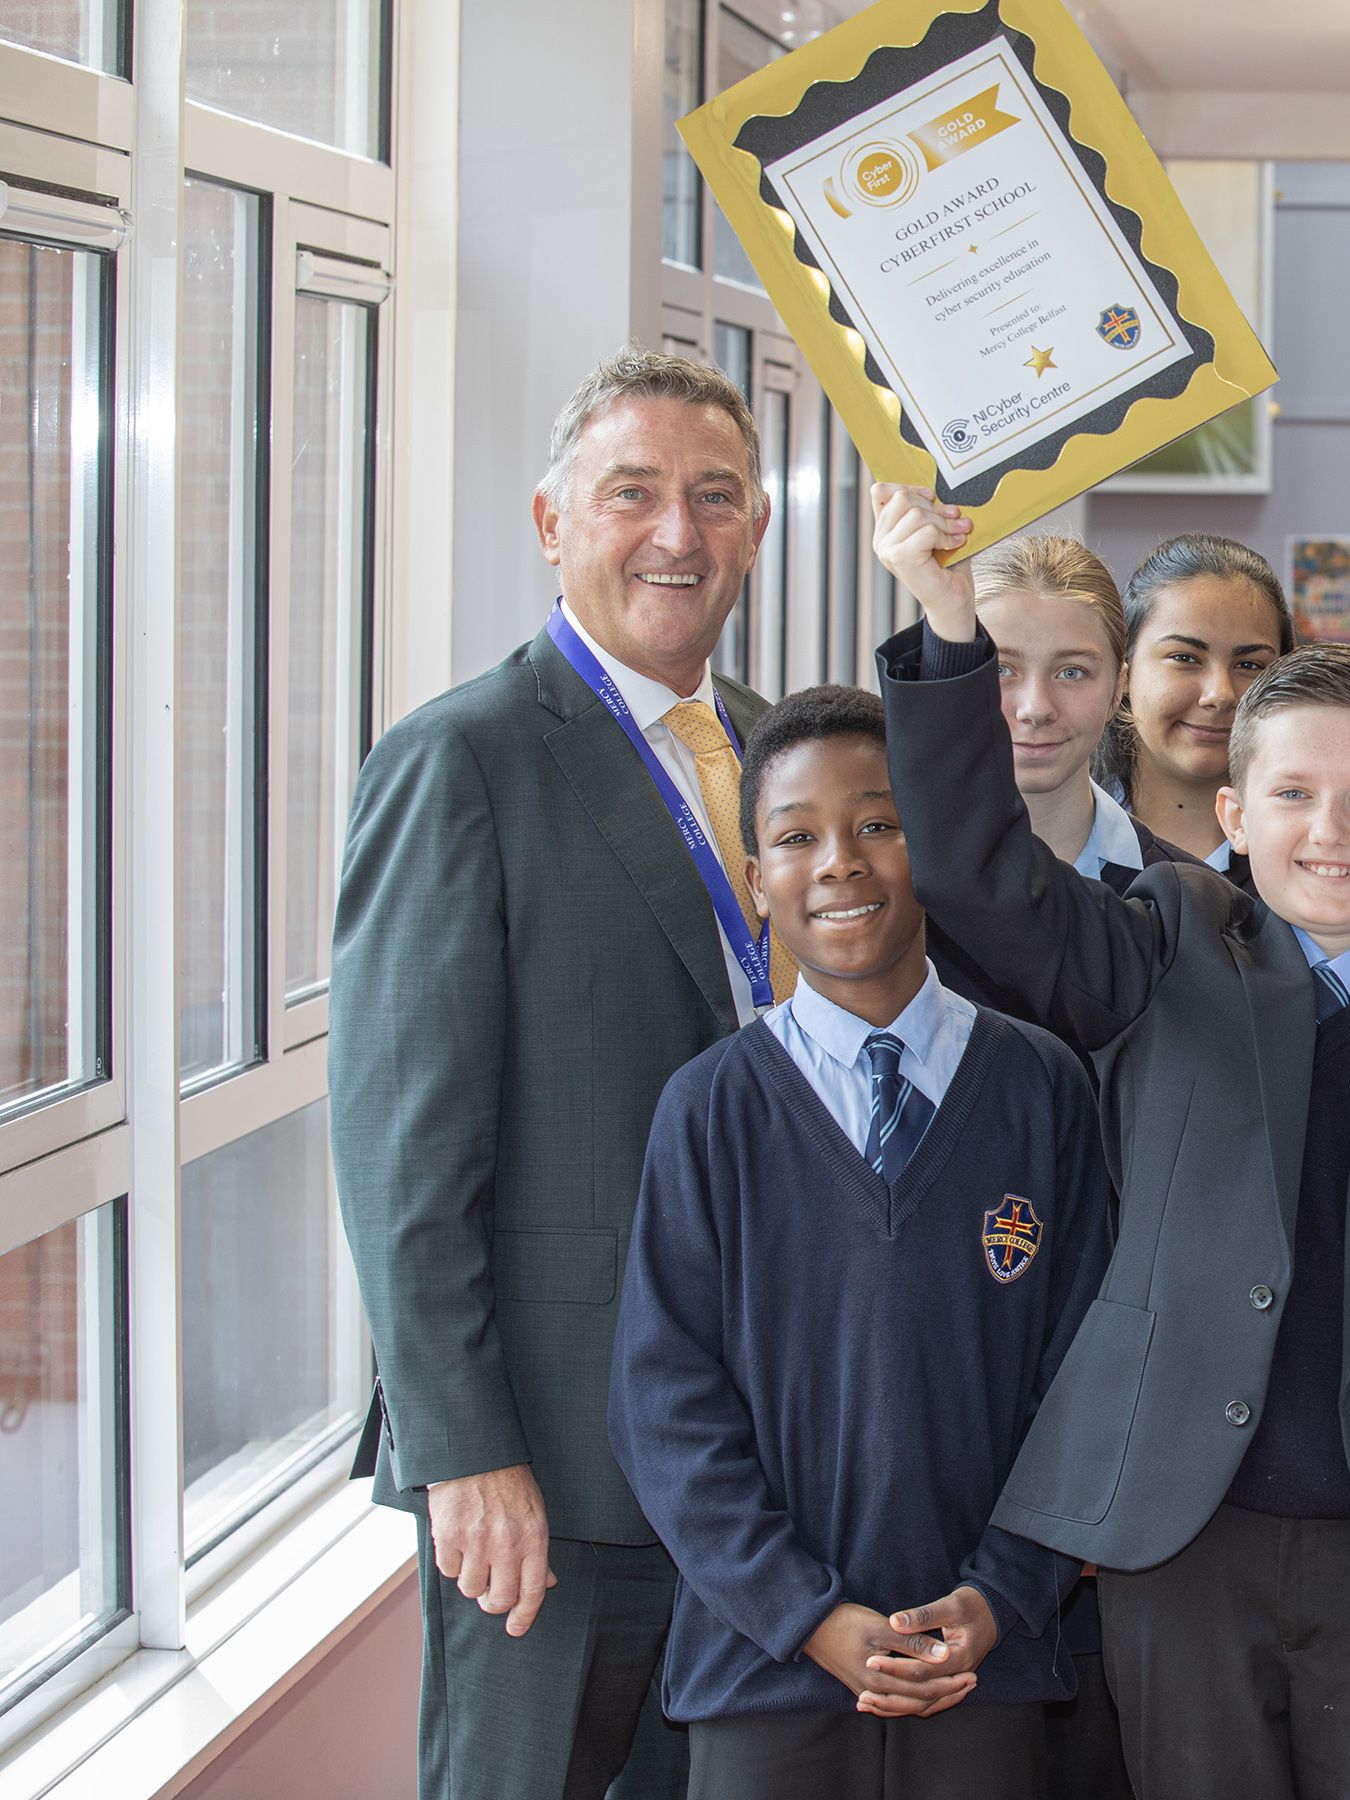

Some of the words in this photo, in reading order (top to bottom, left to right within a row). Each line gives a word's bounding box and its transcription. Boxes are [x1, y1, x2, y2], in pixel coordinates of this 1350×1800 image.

[937, 112, 974, 137] GOLD
[937, 118, 987, 150] AWARD
[862, 160, 893, 181] Cyber
[867, 173, 891, 191] First
[880, 215, 971, 273] CYBERFIRST
[974, 181, 1037, 222] SCHOOL
[895, 211, 939, 241] GOLD
[943, 177, 1000, 217] AWARD
[925, 272, 979, 307] Delivering
[978, 246, 1028, 278] excellence
[1027, 238, 1039, 250] in
[934, 301, 963, 322] cyber
[964, 278, 1002, 307] security
[1002, 251, 1052, 284] education
[979, 340, 1007, 358] Mercy
[1006, 322, 1039, 343] College
[1038, 304, 1067, 325] Belfast
[989, 309, 1030, 336] Presented
[981, 405, 1031, 437] Security
[1029, 382, 1071, 410] Centre
[597, 688, 621, 716] MERCY
[600, 673, 629, 715] COLLEGE
[675, 816, 698, 850] MERCY
[679, 802, 706, 847] COLLEGE
[744, 940, 766, 980] OLLEGE
